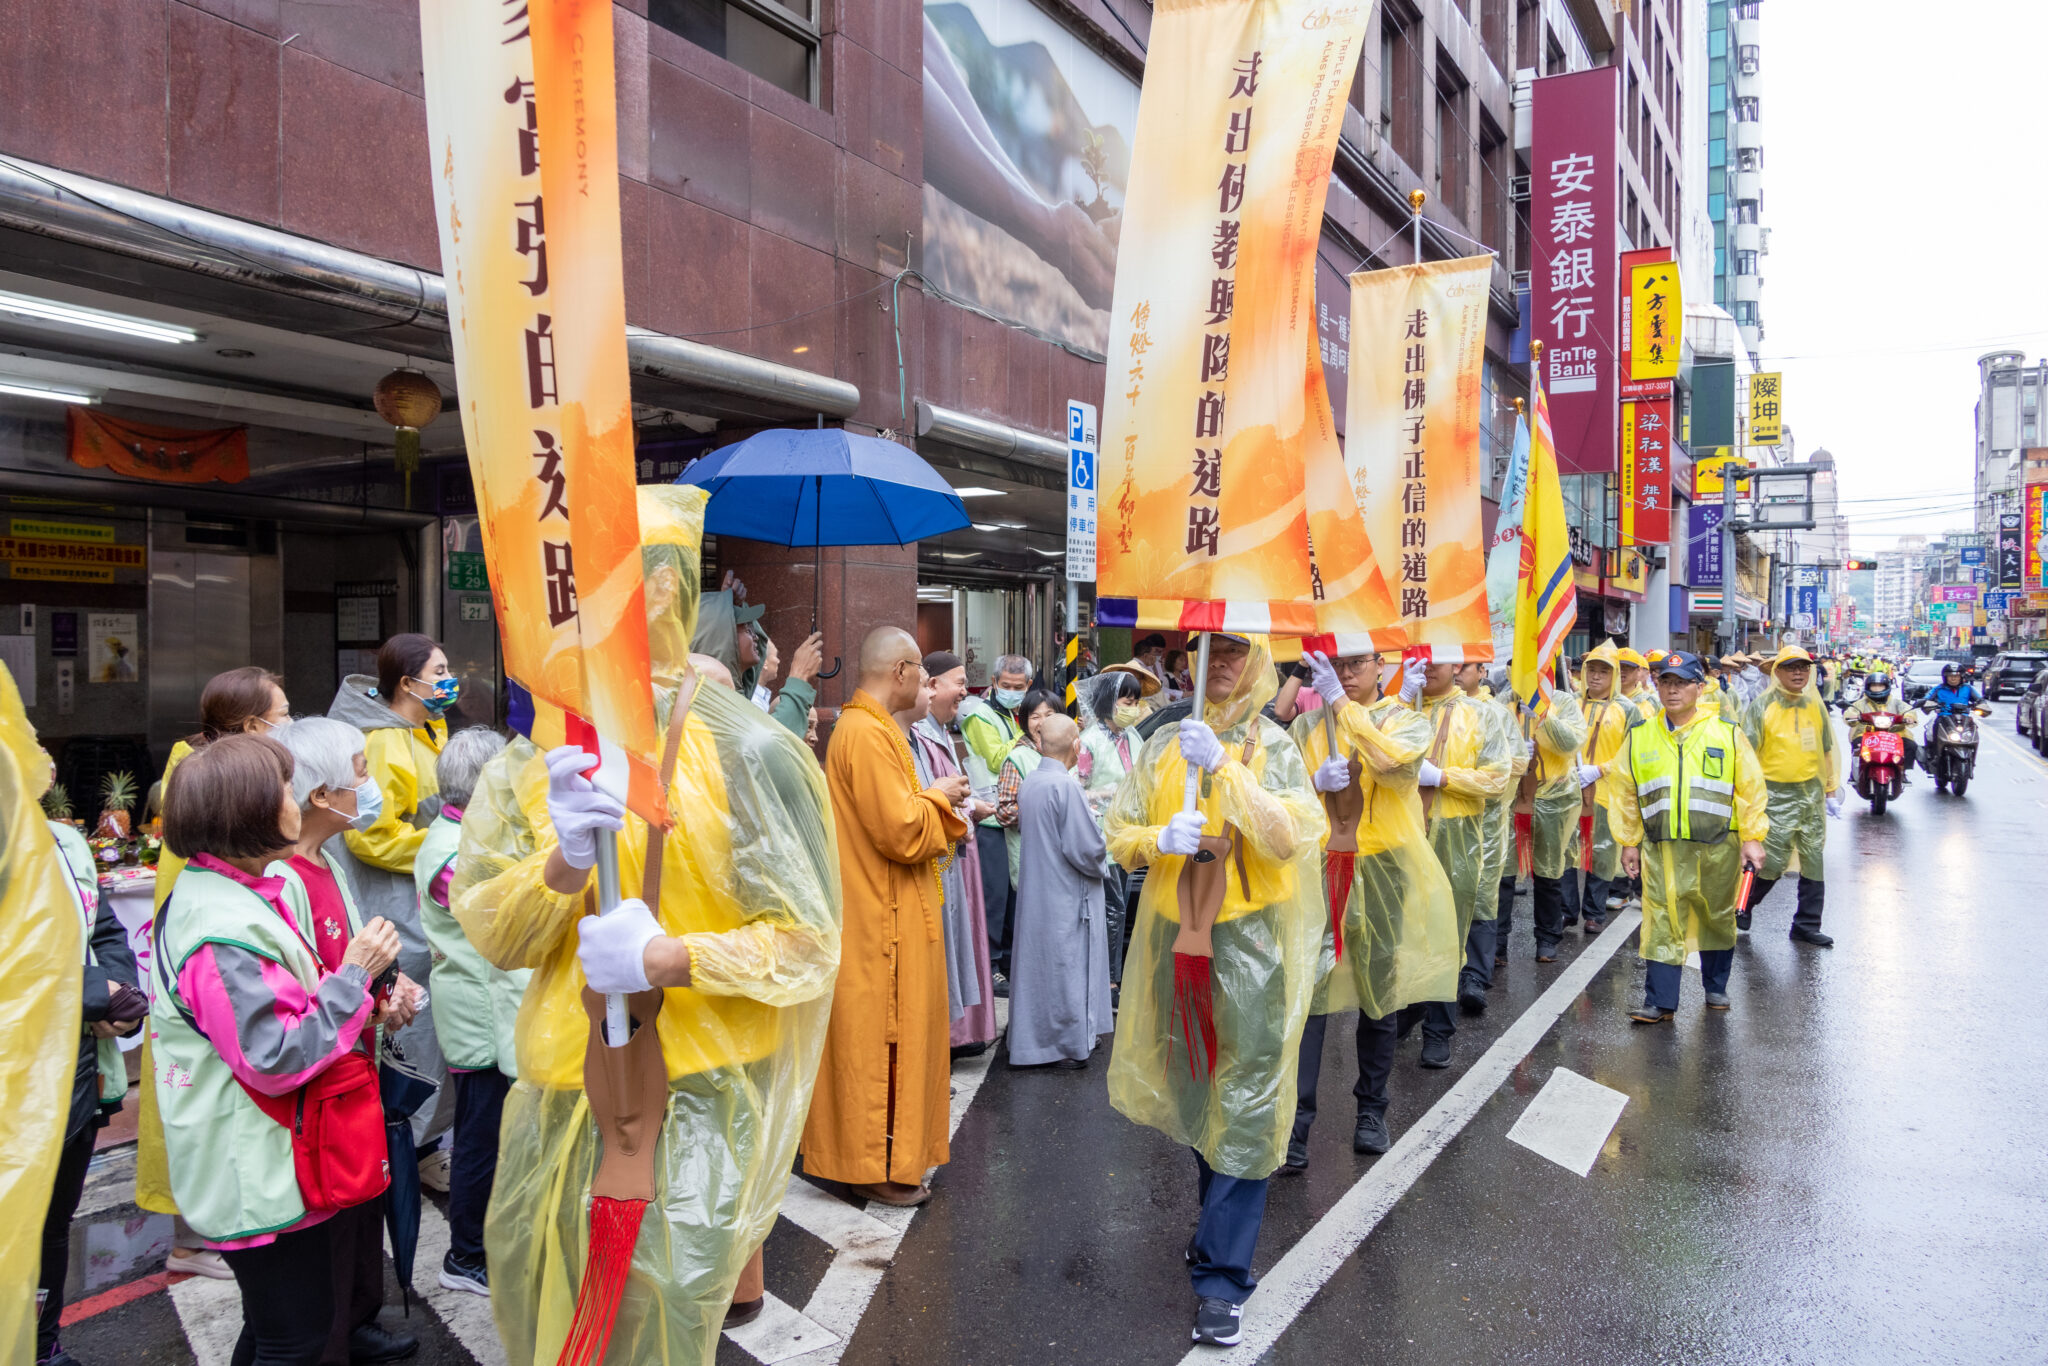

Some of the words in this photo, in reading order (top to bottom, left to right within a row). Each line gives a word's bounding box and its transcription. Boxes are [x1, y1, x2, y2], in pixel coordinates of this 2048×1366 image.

[1319, 40, 1334, 71] ALMS
[1333, 36, 1352, 76] TRIPLE
[571, 33, 589, 198] CEREMONY
[1299, 74, 1325, 147] PROCESSION
[1317, 79, 1340, 140] PLATFORM
[1281, 180, 1301, 249] BLESSINGS
[1550, 152, 1595, 339] 安泰銀行
[1288, 260, 1305, 331] CEREMONY
[1471, 303, 1480, 328] TRIPLE
[1320, 303, 1350, 343] 是一種
[1643, 275, 1669, 365] 八方雲集
[1320, 336, 1349, 374] 溫潤呵
[1550, 346, 1597, 363] EnTie
[1550, 360, 1597, 377] Bank
[1312, 388, 1329, 442] CEREMONY
[1753, 377, 1778, 421] 燦坤
[1400, 308, 1430, 619] 走出佛子正信的道路
[1639, 413, 1664, 510] 梁社漢排骨
[1070, 516, 1095, 534] 停車位
[465, 563, 480, 575] 21
[465, 576, 481, 588] 29
[469, 607, 481, 619] 21
